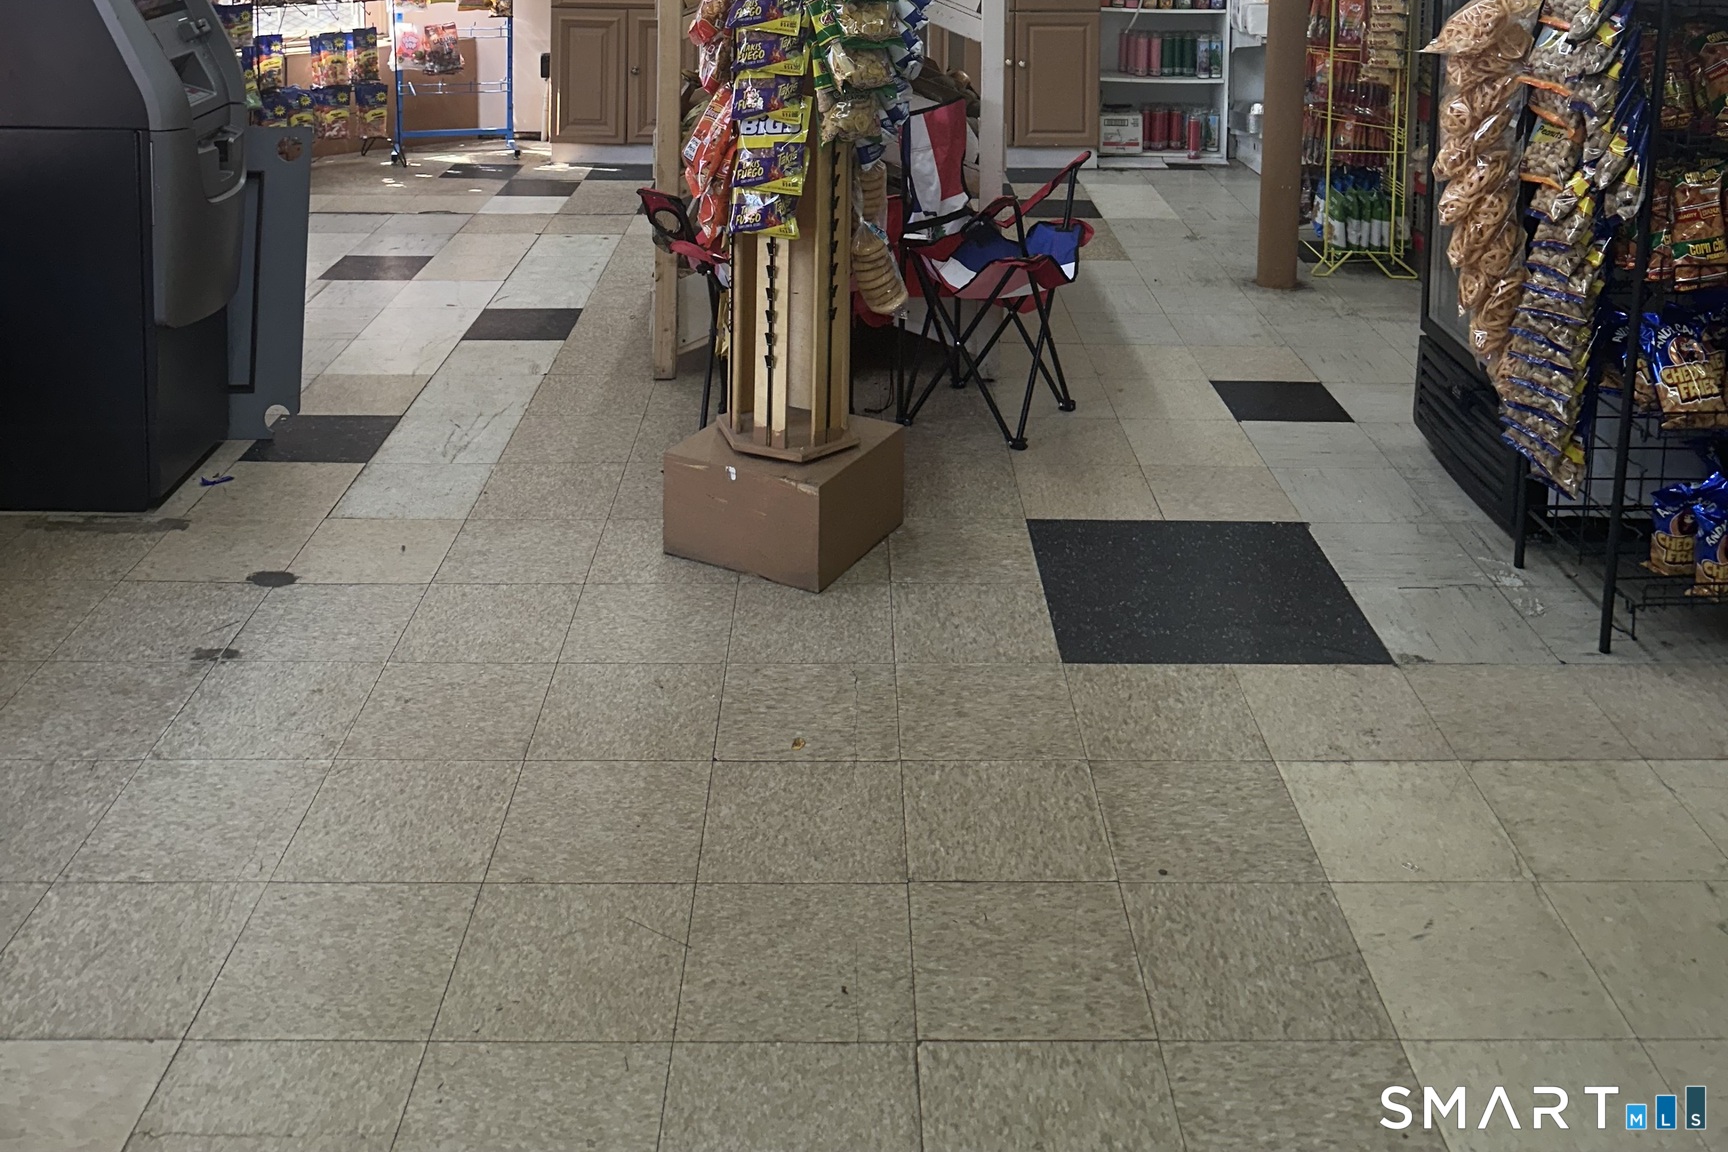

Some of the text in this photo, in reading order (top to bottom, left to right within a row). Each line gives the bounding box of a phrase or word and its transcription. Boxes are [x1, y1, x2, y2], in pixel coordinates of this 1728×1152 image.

[1537, 125, 1564, 139] Peanuts
[777, 150, 798, 167] Takis
[736, 167, 764, 180] FUEGO
[1678, 378, 1719, 400] FRIES
